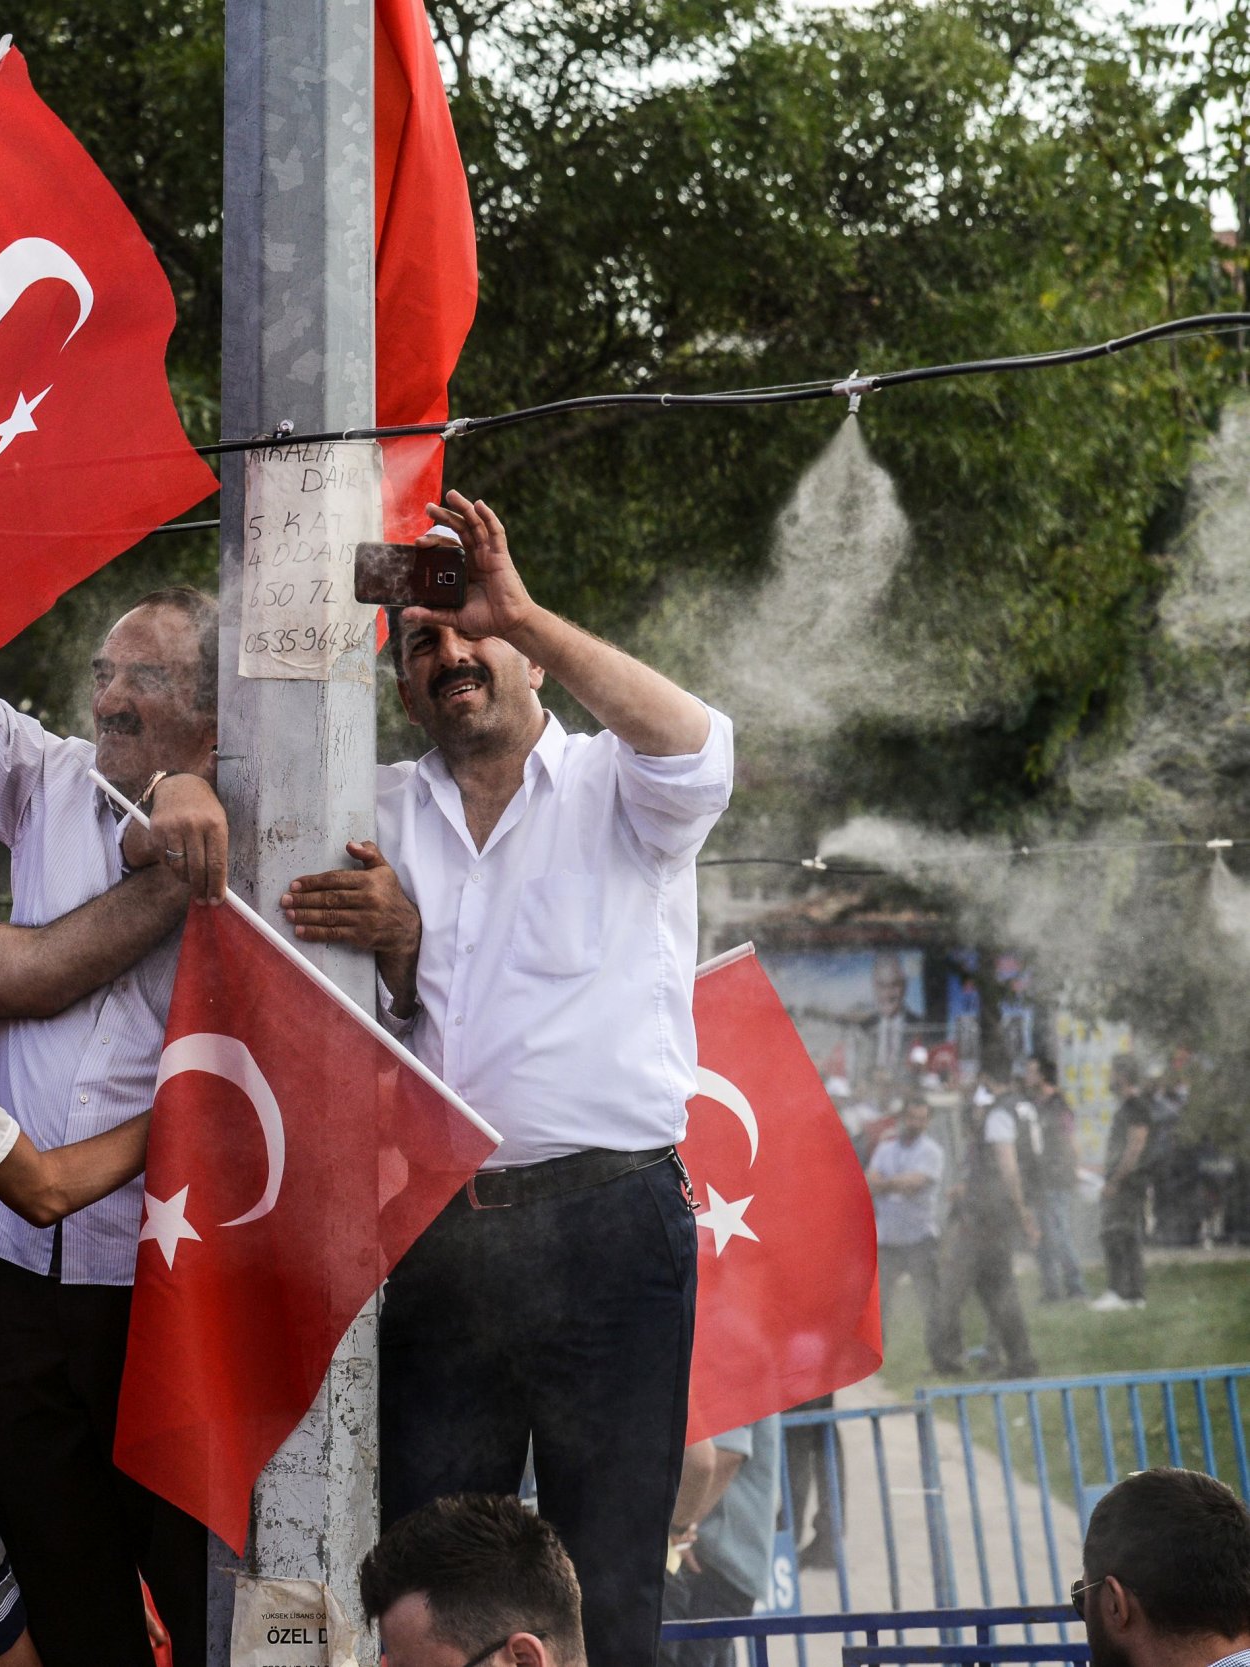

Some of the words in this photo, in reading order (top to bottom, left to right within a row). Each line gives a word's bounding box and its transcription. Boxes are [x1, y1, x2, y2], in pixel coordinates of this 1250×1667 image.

[283, 511, 343, 536] KAT
[248, 547, 262, 572] 4
[271, 541, 331, 567] ODA
[250, 581, 295, 608] 650
[310, 580, 337, 604] TL
[267, 1626, 313, 1644] ÖZEL
